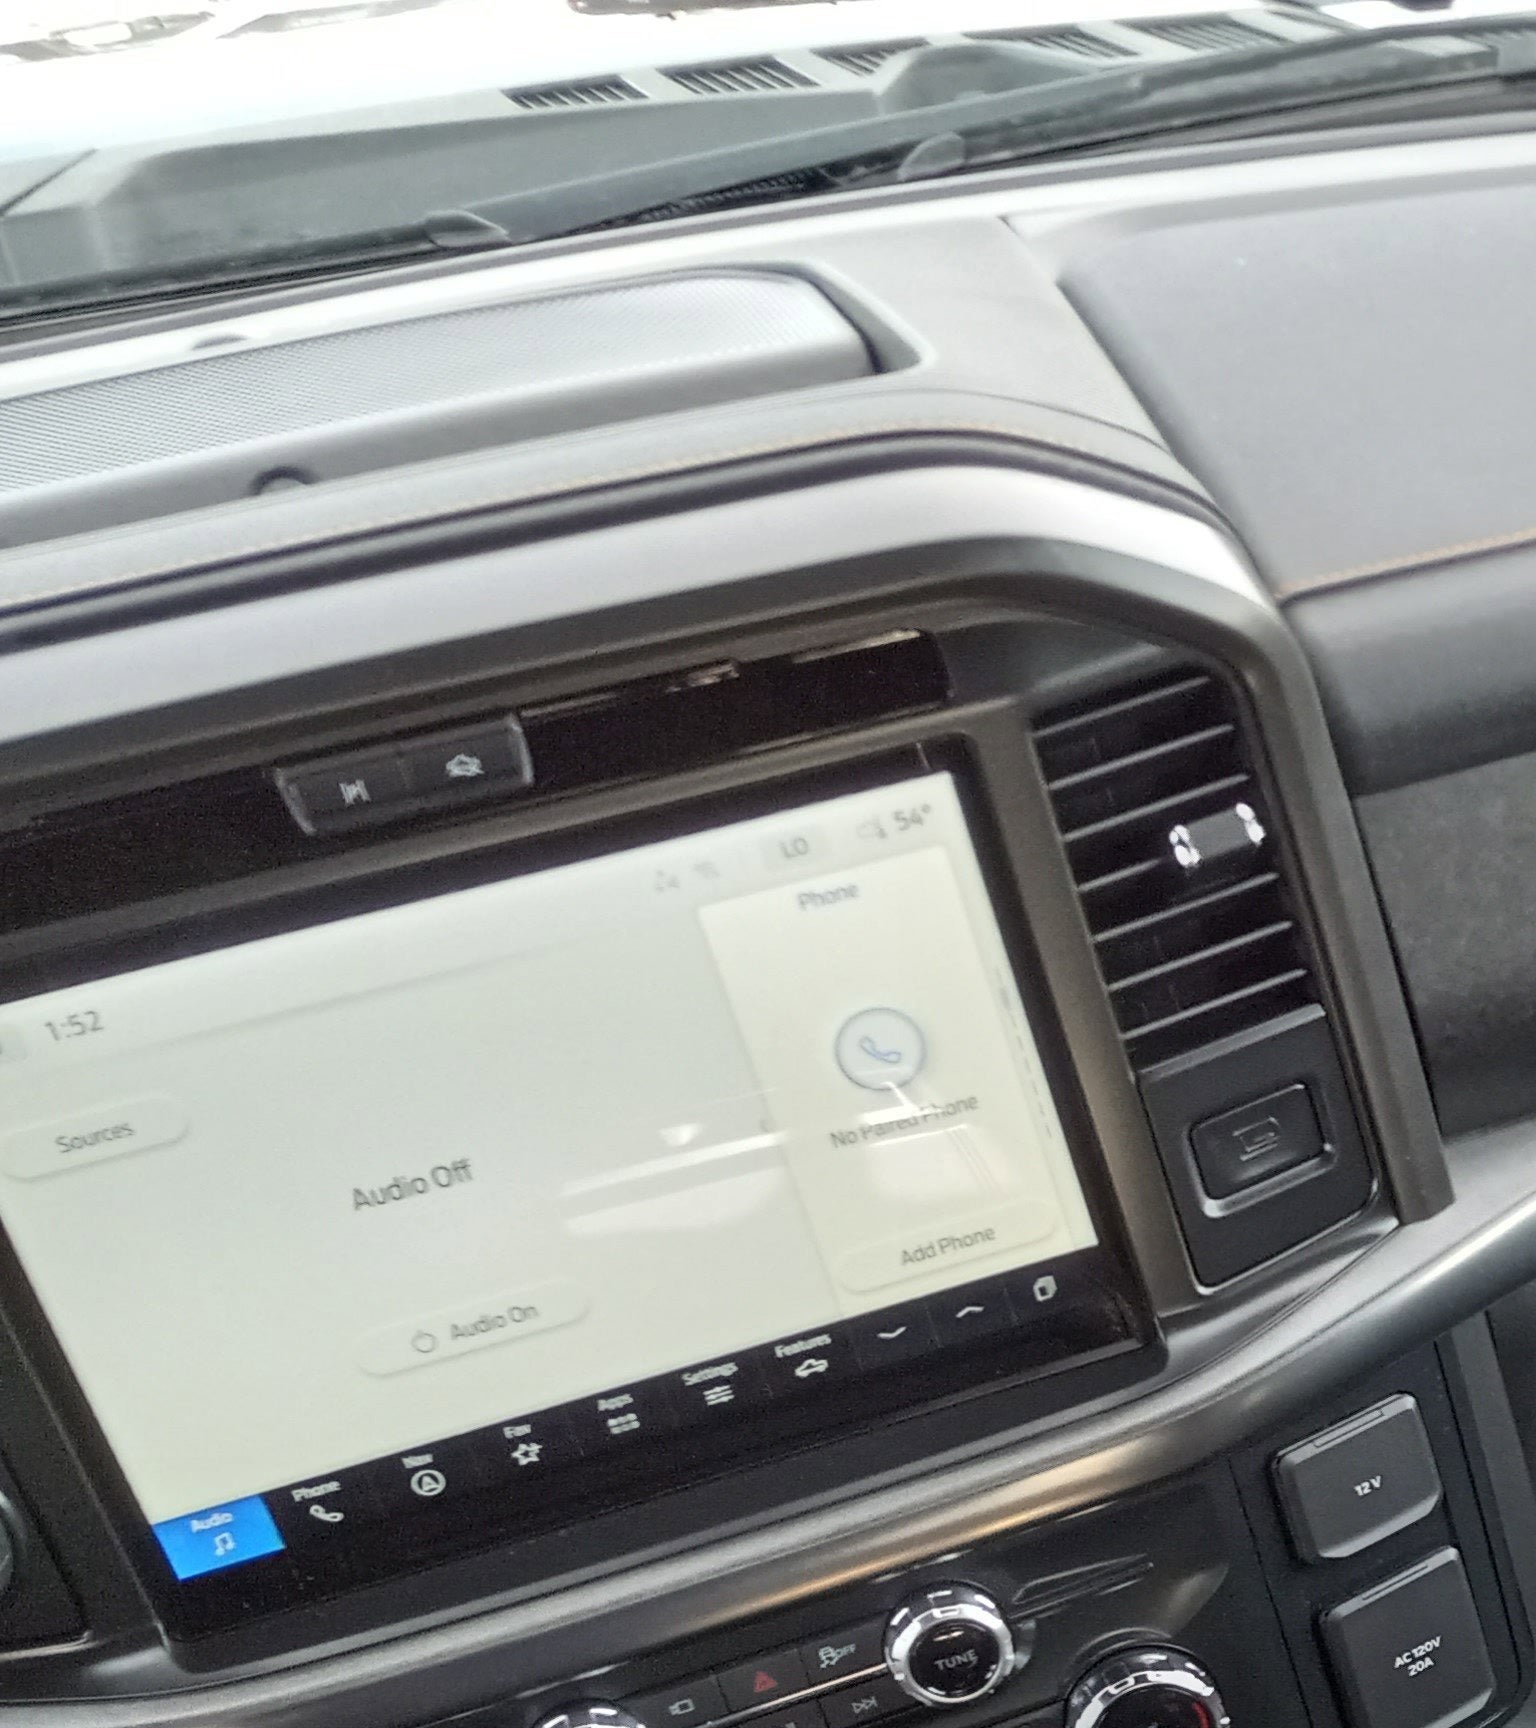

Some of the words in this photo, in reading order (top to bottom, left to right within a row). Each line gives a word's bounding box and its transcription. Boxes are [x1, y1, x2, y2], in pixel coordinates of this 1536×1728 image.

[780, 837, 809, 859] LO
[798, 885, 859, 910] Phone
[45, 1010, 104, 1041] 1:52
[55, 1122, 136, 1153] Sources
[830, 1130, 858, 1149] No
[920, 1096, 979, 1125] Phone
[353, 1176, 429, 1210] Audio
[430, 1157, 473, 1188] Off
[901, 1241, 937, 1266] Add
[938, 1227, 996, 1255] Phone
[450, 1314, 507, 1340] Audio
[507, 1305, 540, 1323] On
[291, 1480, 342, 1502] Phone
[190, 1512, 234, 1533] Audio
[933, 1649, 979, 1672] TUNE
[1394, 1652, 1413, 1669] AC
[1412, 1635, 1442, 1659] 120V
[1408, 1656, 1435, 1677] 20A
